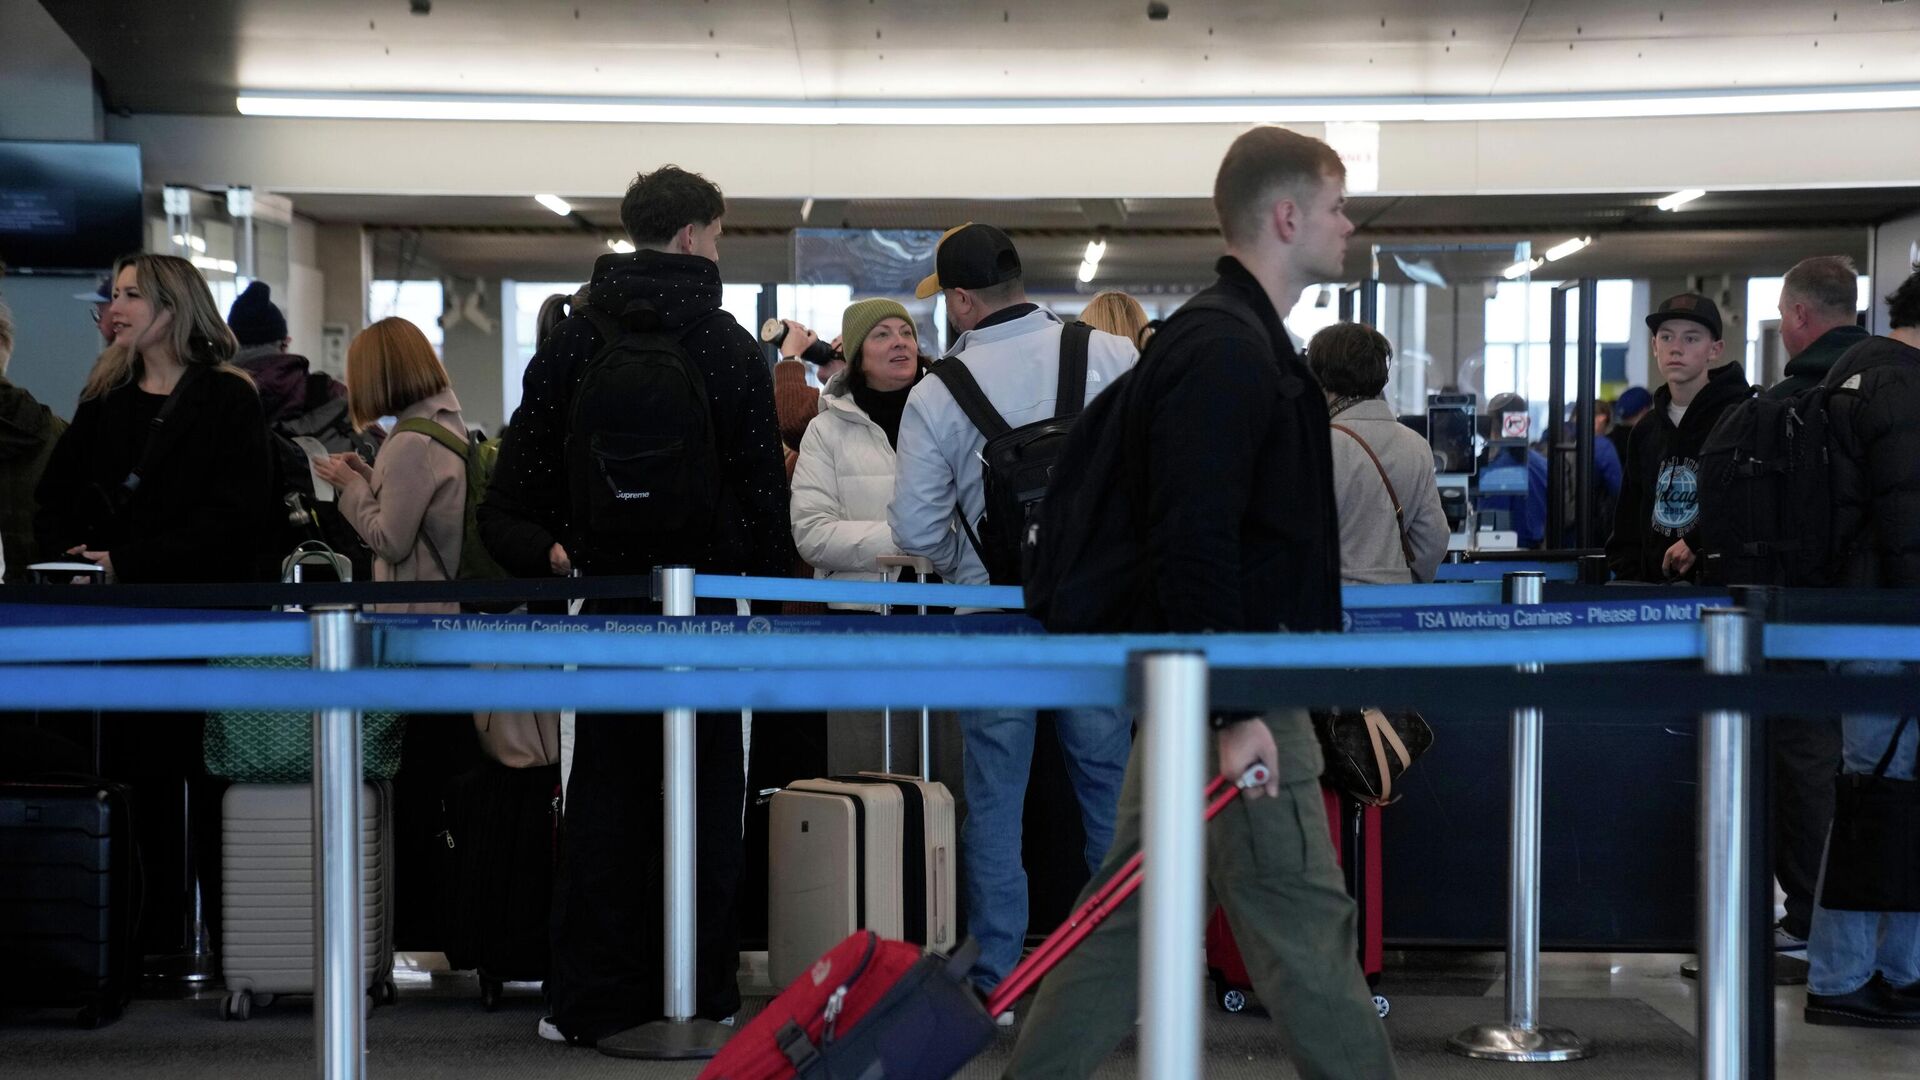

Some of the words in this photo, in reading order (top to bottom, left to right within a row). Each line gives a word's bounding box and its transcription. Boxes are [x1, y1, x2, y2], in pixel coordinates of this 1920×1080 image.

[616, 490, 650, 501] Supreme
[1415, 611, 1447, 628] TSA
[1449, 609, 1510, 630] Working
[1514, 609, 1573, 626] Canines
[1587, 606, 1637, 623] Please
[1641, 605, 1662, 622] Do
[1665, 604, 1692, 620] Not
[432, 619, 461, 632] TSA
[466, 619, 526, 632] Working
[531, 620, 589, 633] Canines
[605, 621, 652, 633] Please
[657, 621, 677, 633] Do
[682, 621, 707, 633] Not
[711, 621, 735, 633] Pet
